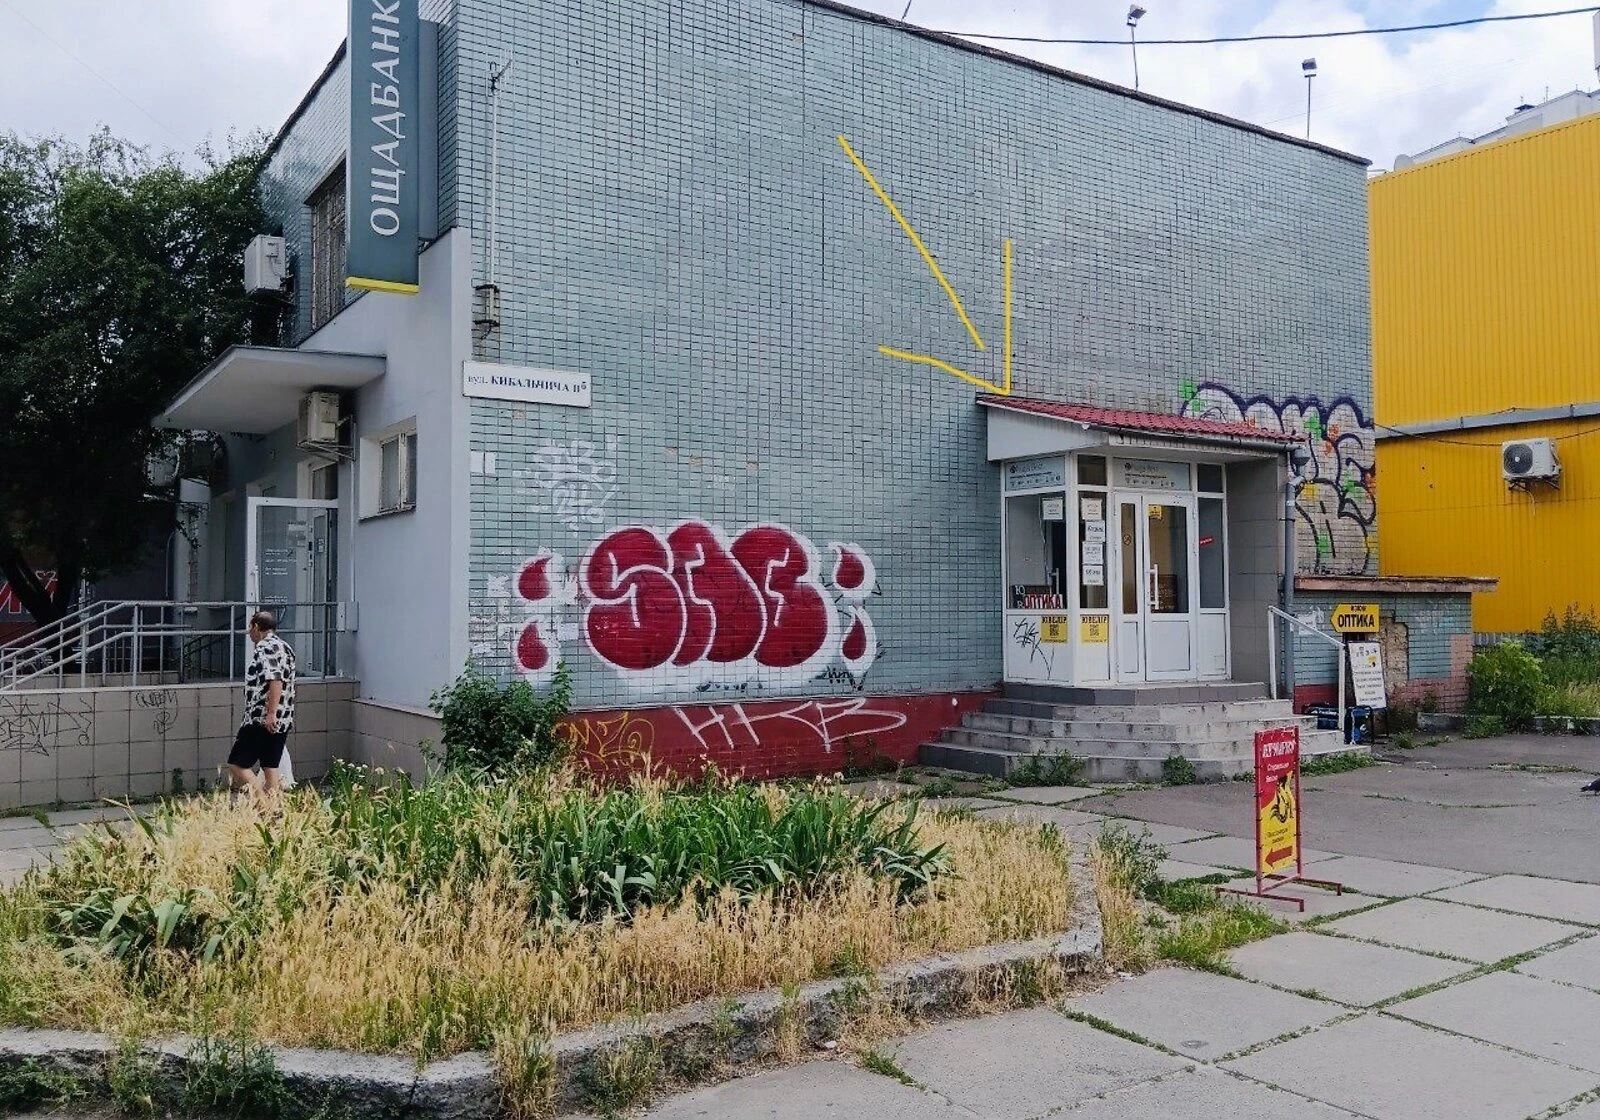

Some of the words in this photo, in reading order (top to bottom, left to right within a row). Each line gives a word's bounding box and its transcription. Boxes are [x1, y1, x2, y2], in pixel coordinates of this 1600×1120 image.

[370, 0, 406, 237] ОЩАДБАНК
[491, 375, 570, 393] КИБАЛЬЧИЧА
[1024, 594, 1062, 609] ОПТИКА
[1337, 613, 1375, 628] ОПТИКА
